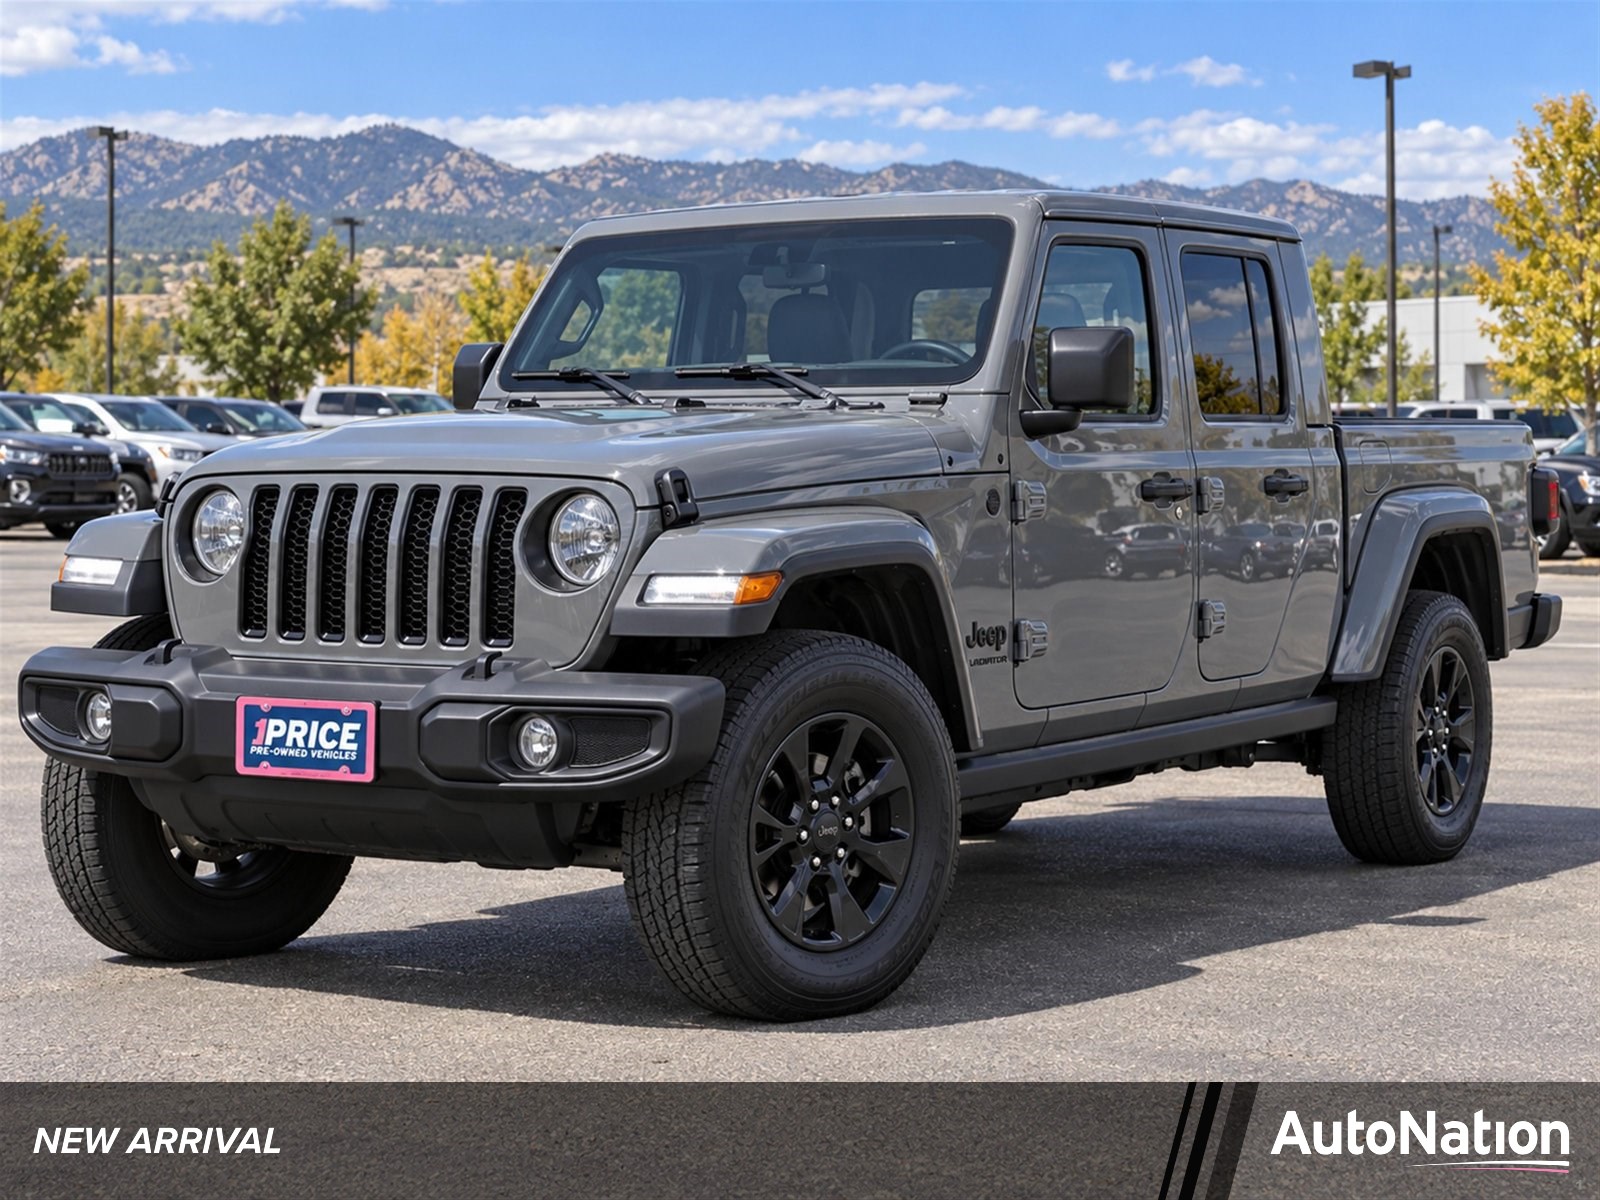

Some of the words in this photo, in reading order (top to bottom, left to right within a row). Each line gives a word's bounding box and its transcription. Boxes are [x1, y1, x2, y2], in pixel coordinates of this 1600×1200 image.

[965, 621, 1007, 651] Jeep
[250, 746, 308, 758] PRE-OWNED
[311, 750, 357, 761] VEHICLES
[818, 825, 838, 837] Jeep
